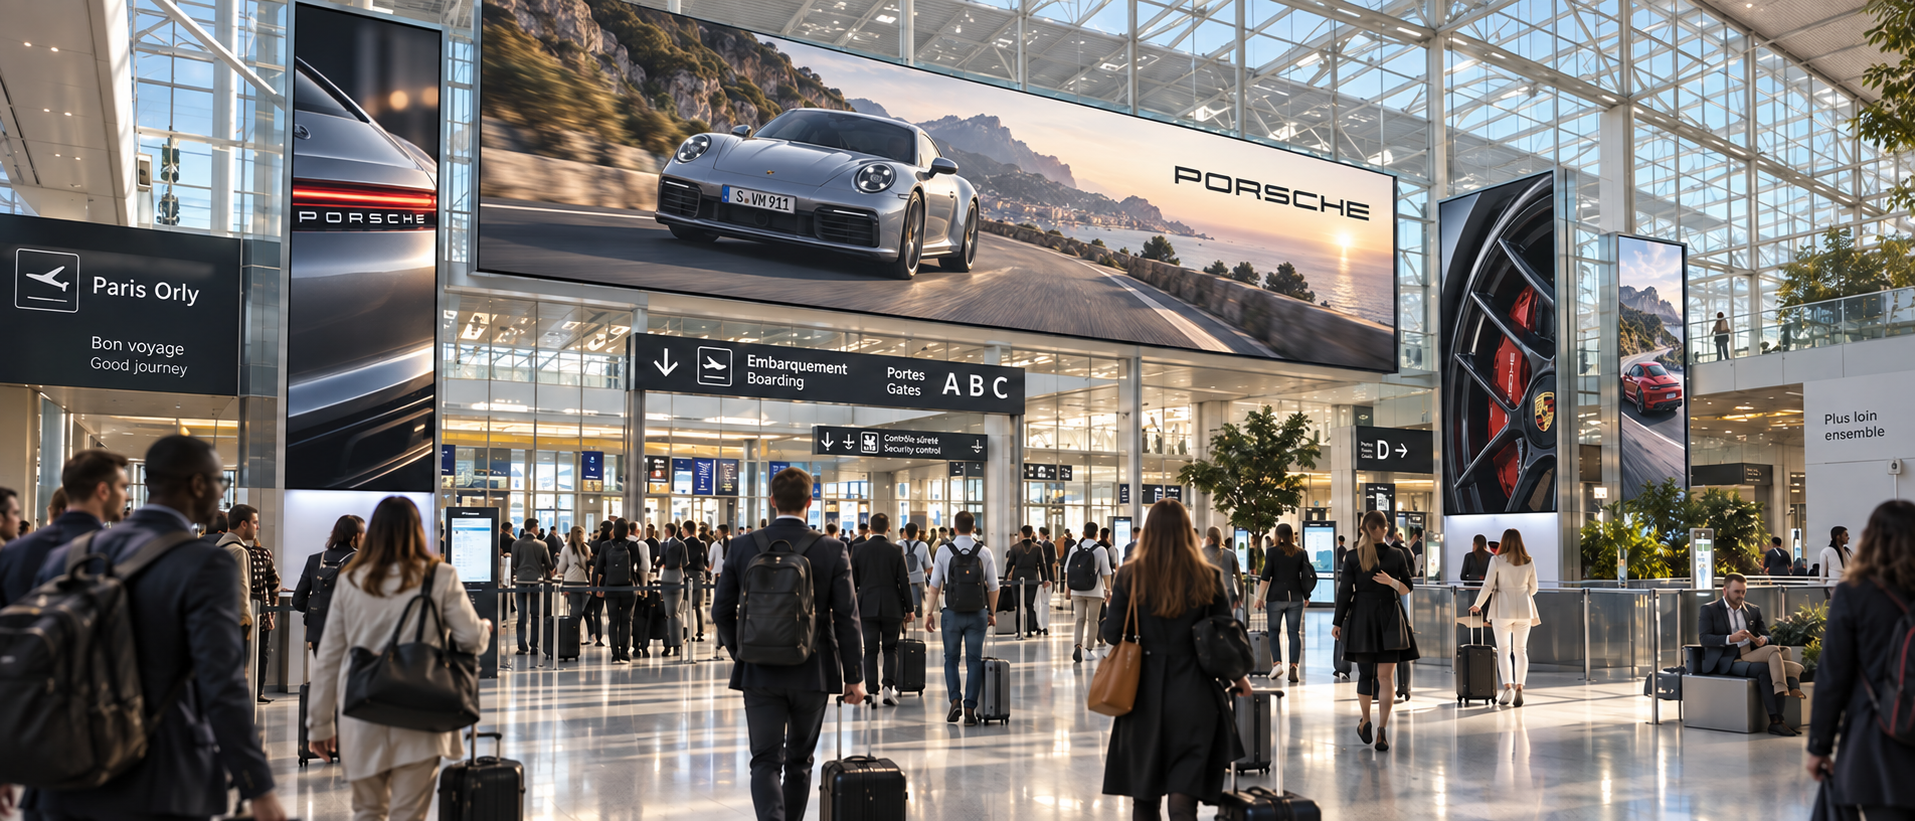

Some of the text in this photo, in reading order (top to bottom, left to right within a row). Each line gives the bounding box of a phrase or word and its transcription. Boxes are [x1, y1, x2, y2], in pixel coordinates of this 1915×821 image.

[736, 190, 744, 203] S
[768, 195, 790, 211] 911
[1174, 165, 1370, 221] PORSCHE
[298, 211, 426, 224] PORSCHE
[93, 276, 200, 307] Paris Orly
[91, 335, 185, 358] Bon voyage
[90, 356, 188, 378] Good journey
[747, 354, 848, 375] Embarquement
[887, 366, 926, 381] Portes
[747, 371, 805, 391] Boarding
[886, 382, 922, 397] Gates
[941, 372, 1009, 399] A B C
[1824, 409, 1878, 425] Plus loin
[1824, 425, 1885, 441] ensemble
[915, 446, 942, 455] control
[1376, 439, 1390, 460] D
